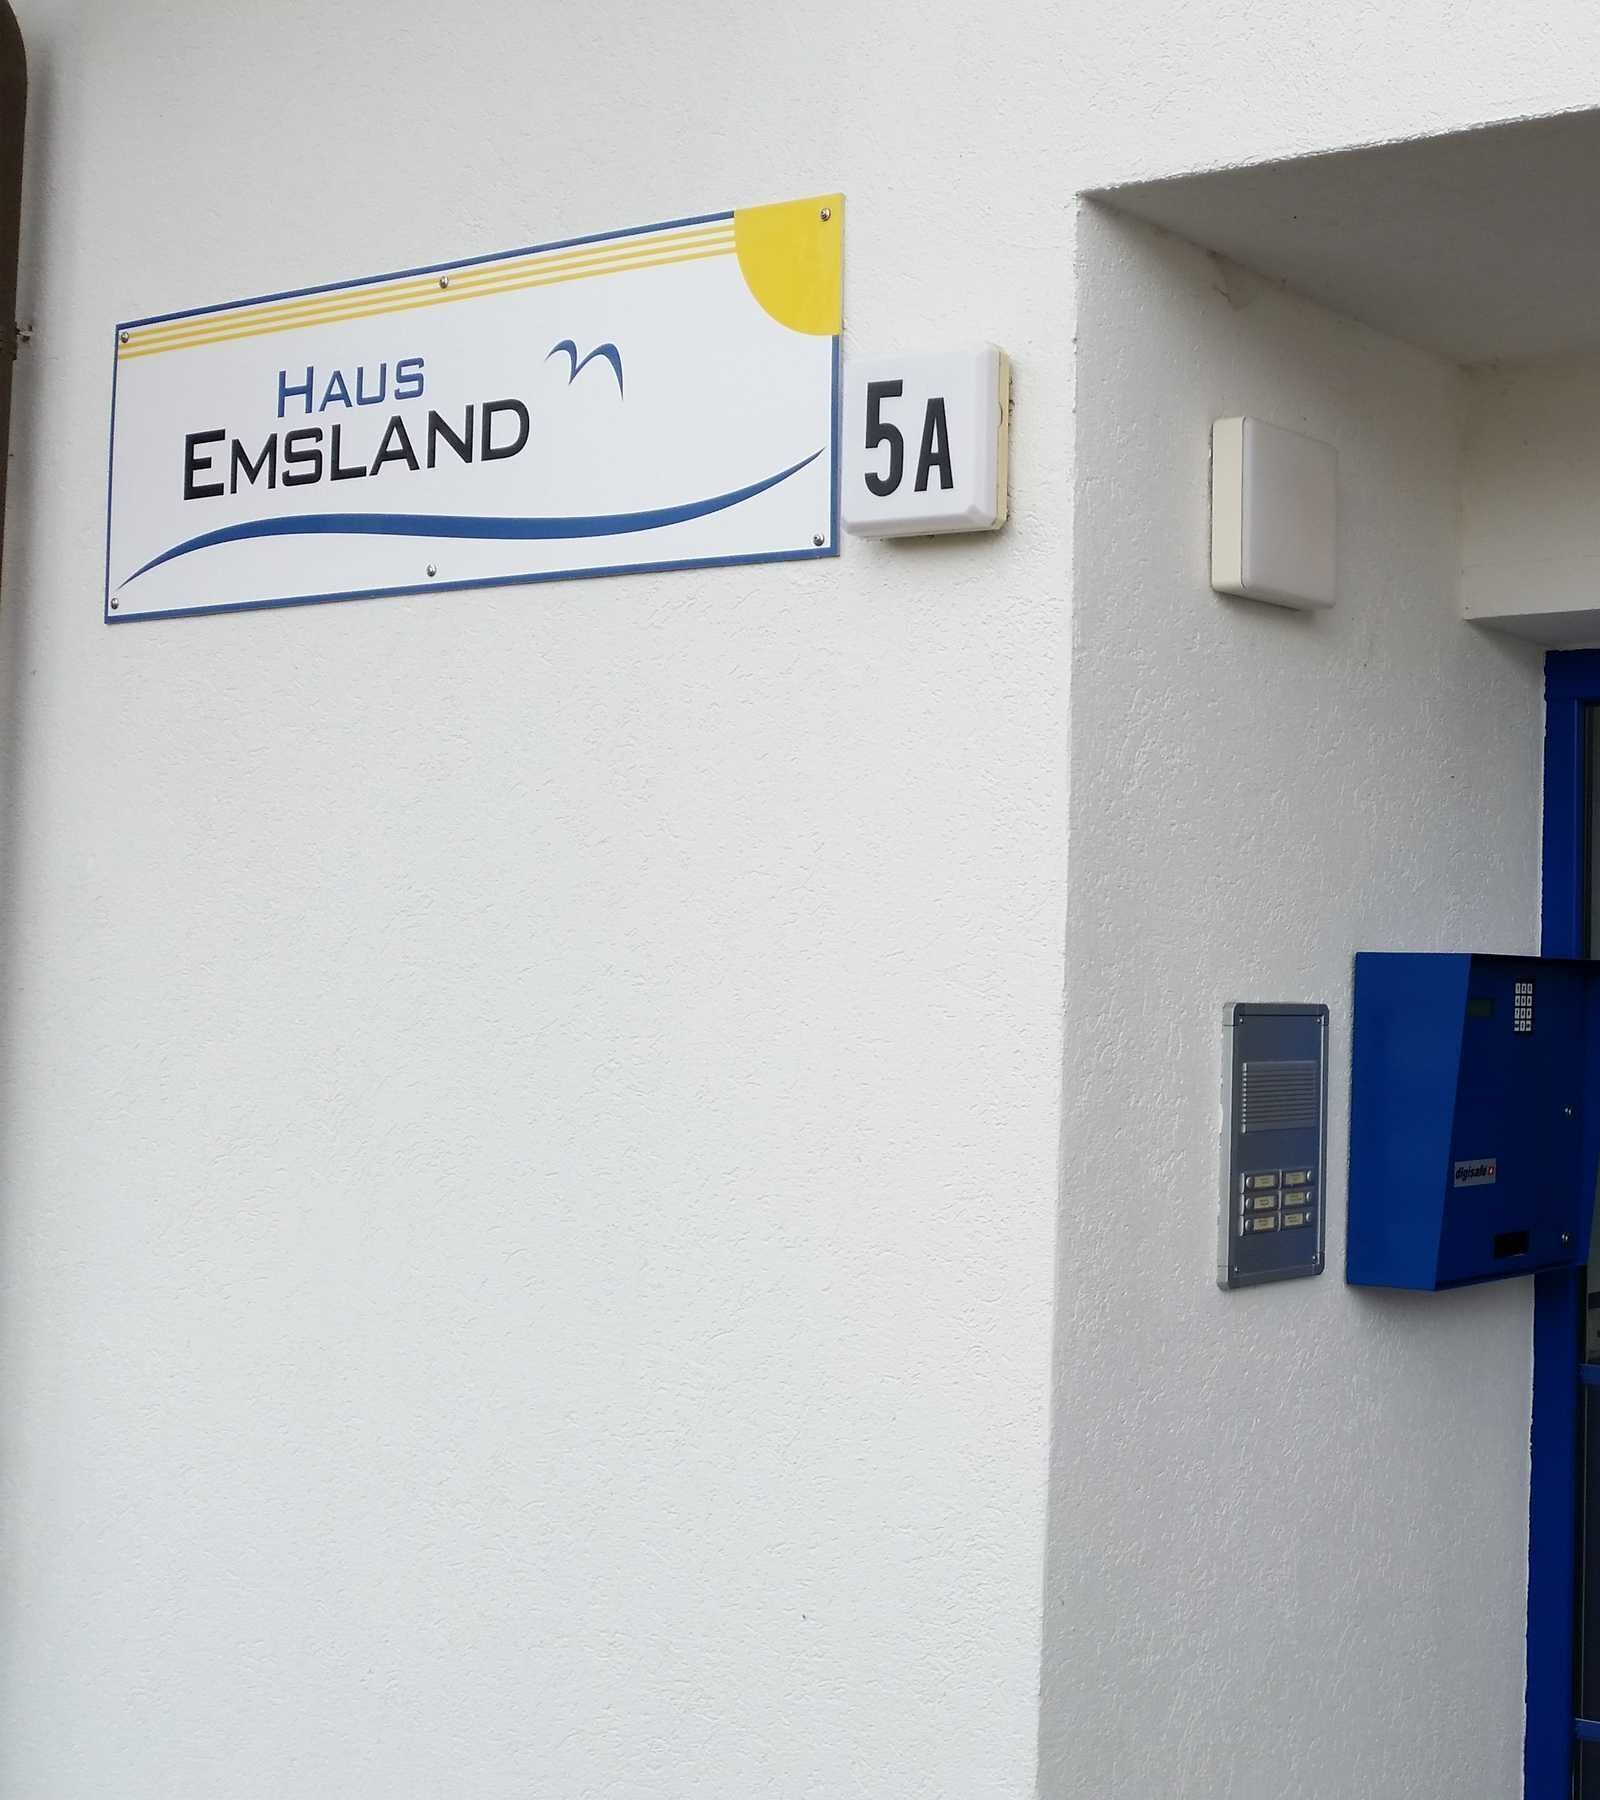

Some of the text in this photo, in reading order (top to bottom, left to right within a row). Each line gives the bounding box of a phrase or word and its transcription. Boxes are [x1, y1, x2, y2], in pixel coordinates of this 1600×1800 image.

[277, 356, 426, 418] HAUS
[864, 379, 955, 497] 5A
[183, 398, 530, 500] EMSLAND
